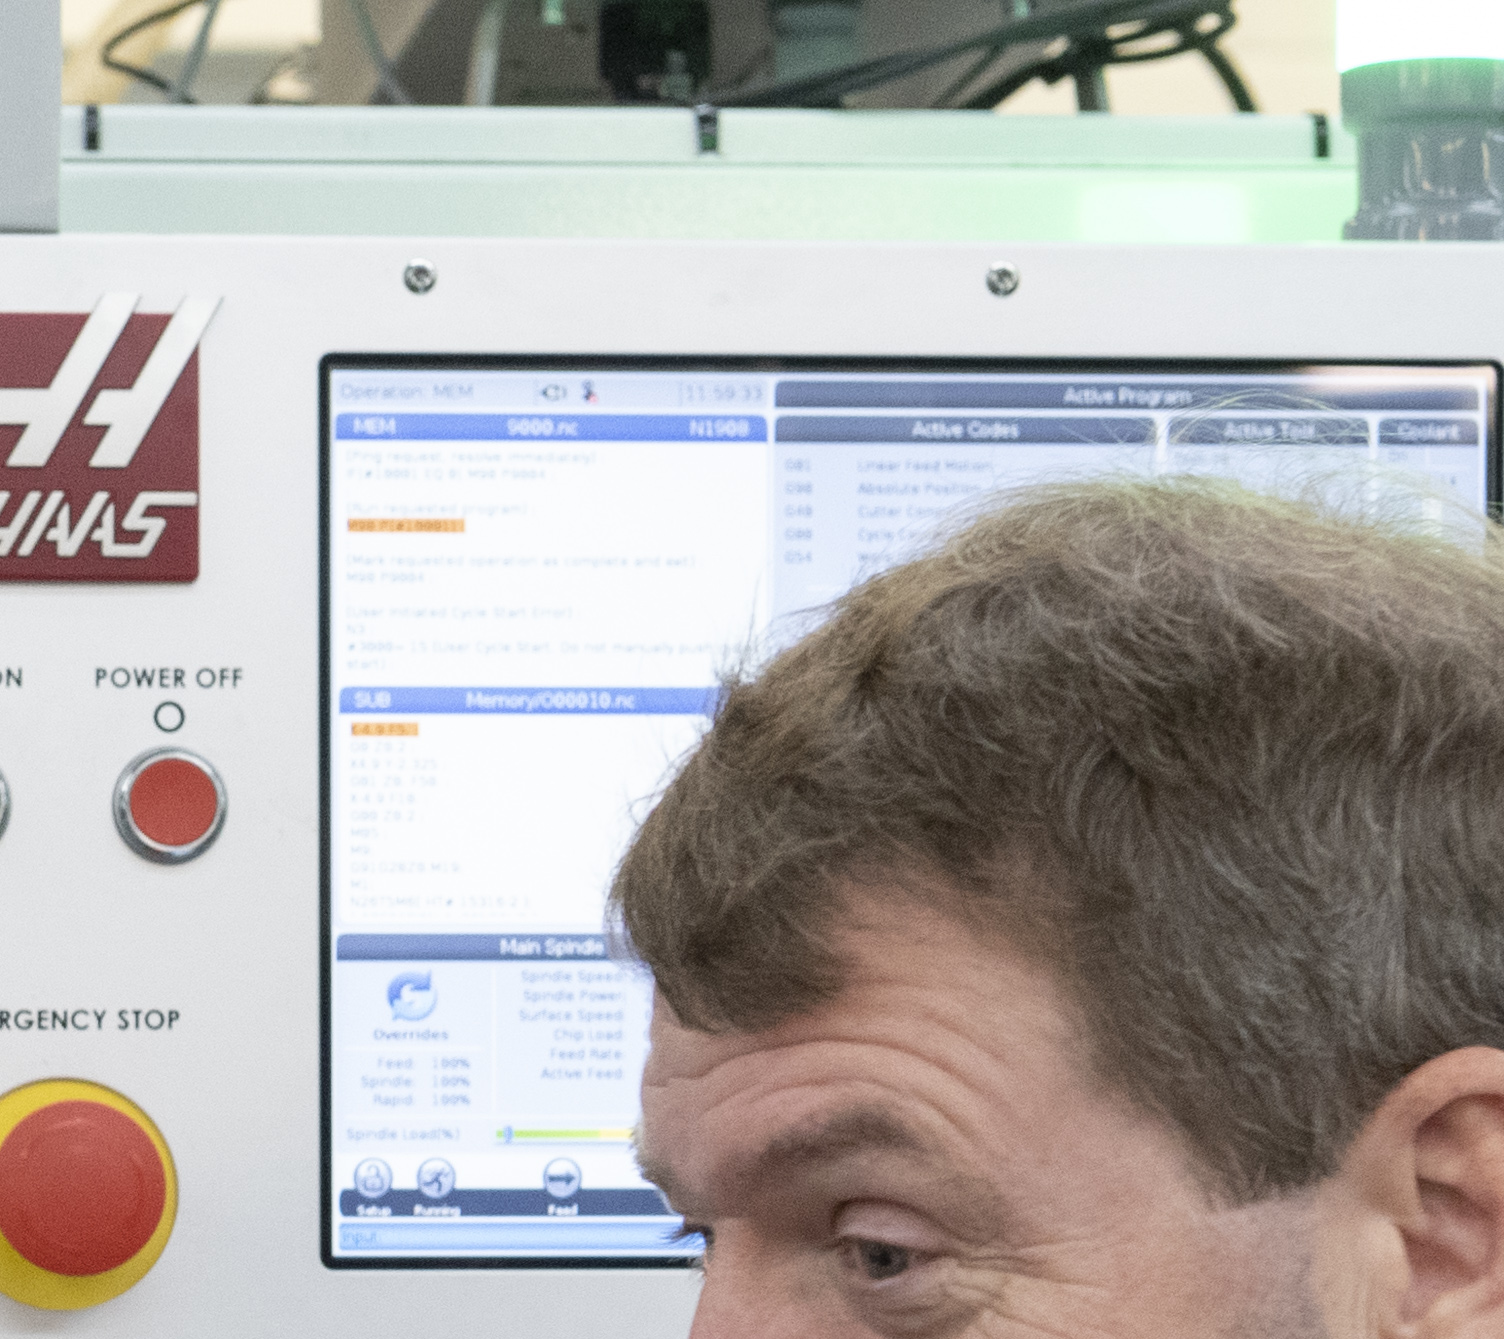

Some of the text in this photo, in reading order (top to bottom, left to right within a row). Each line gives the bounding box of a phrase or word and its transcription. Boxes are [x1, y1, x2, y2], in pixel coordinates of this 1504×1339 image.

[433, 384, 474, 398] MEM
[1063, 387, 1193, 407] Active Program
[353, 417, 397, 434] MEM
[912, 421, 1019, 438] Active Codes
[96, 667, 243, 687] POWER OFF
[354, 691, 392, 708] SUB
[499, 938, 540, 954] Main
[118, 1009, 181, 1030] STOP
[373, 1027, 450, 1041] Overrides
